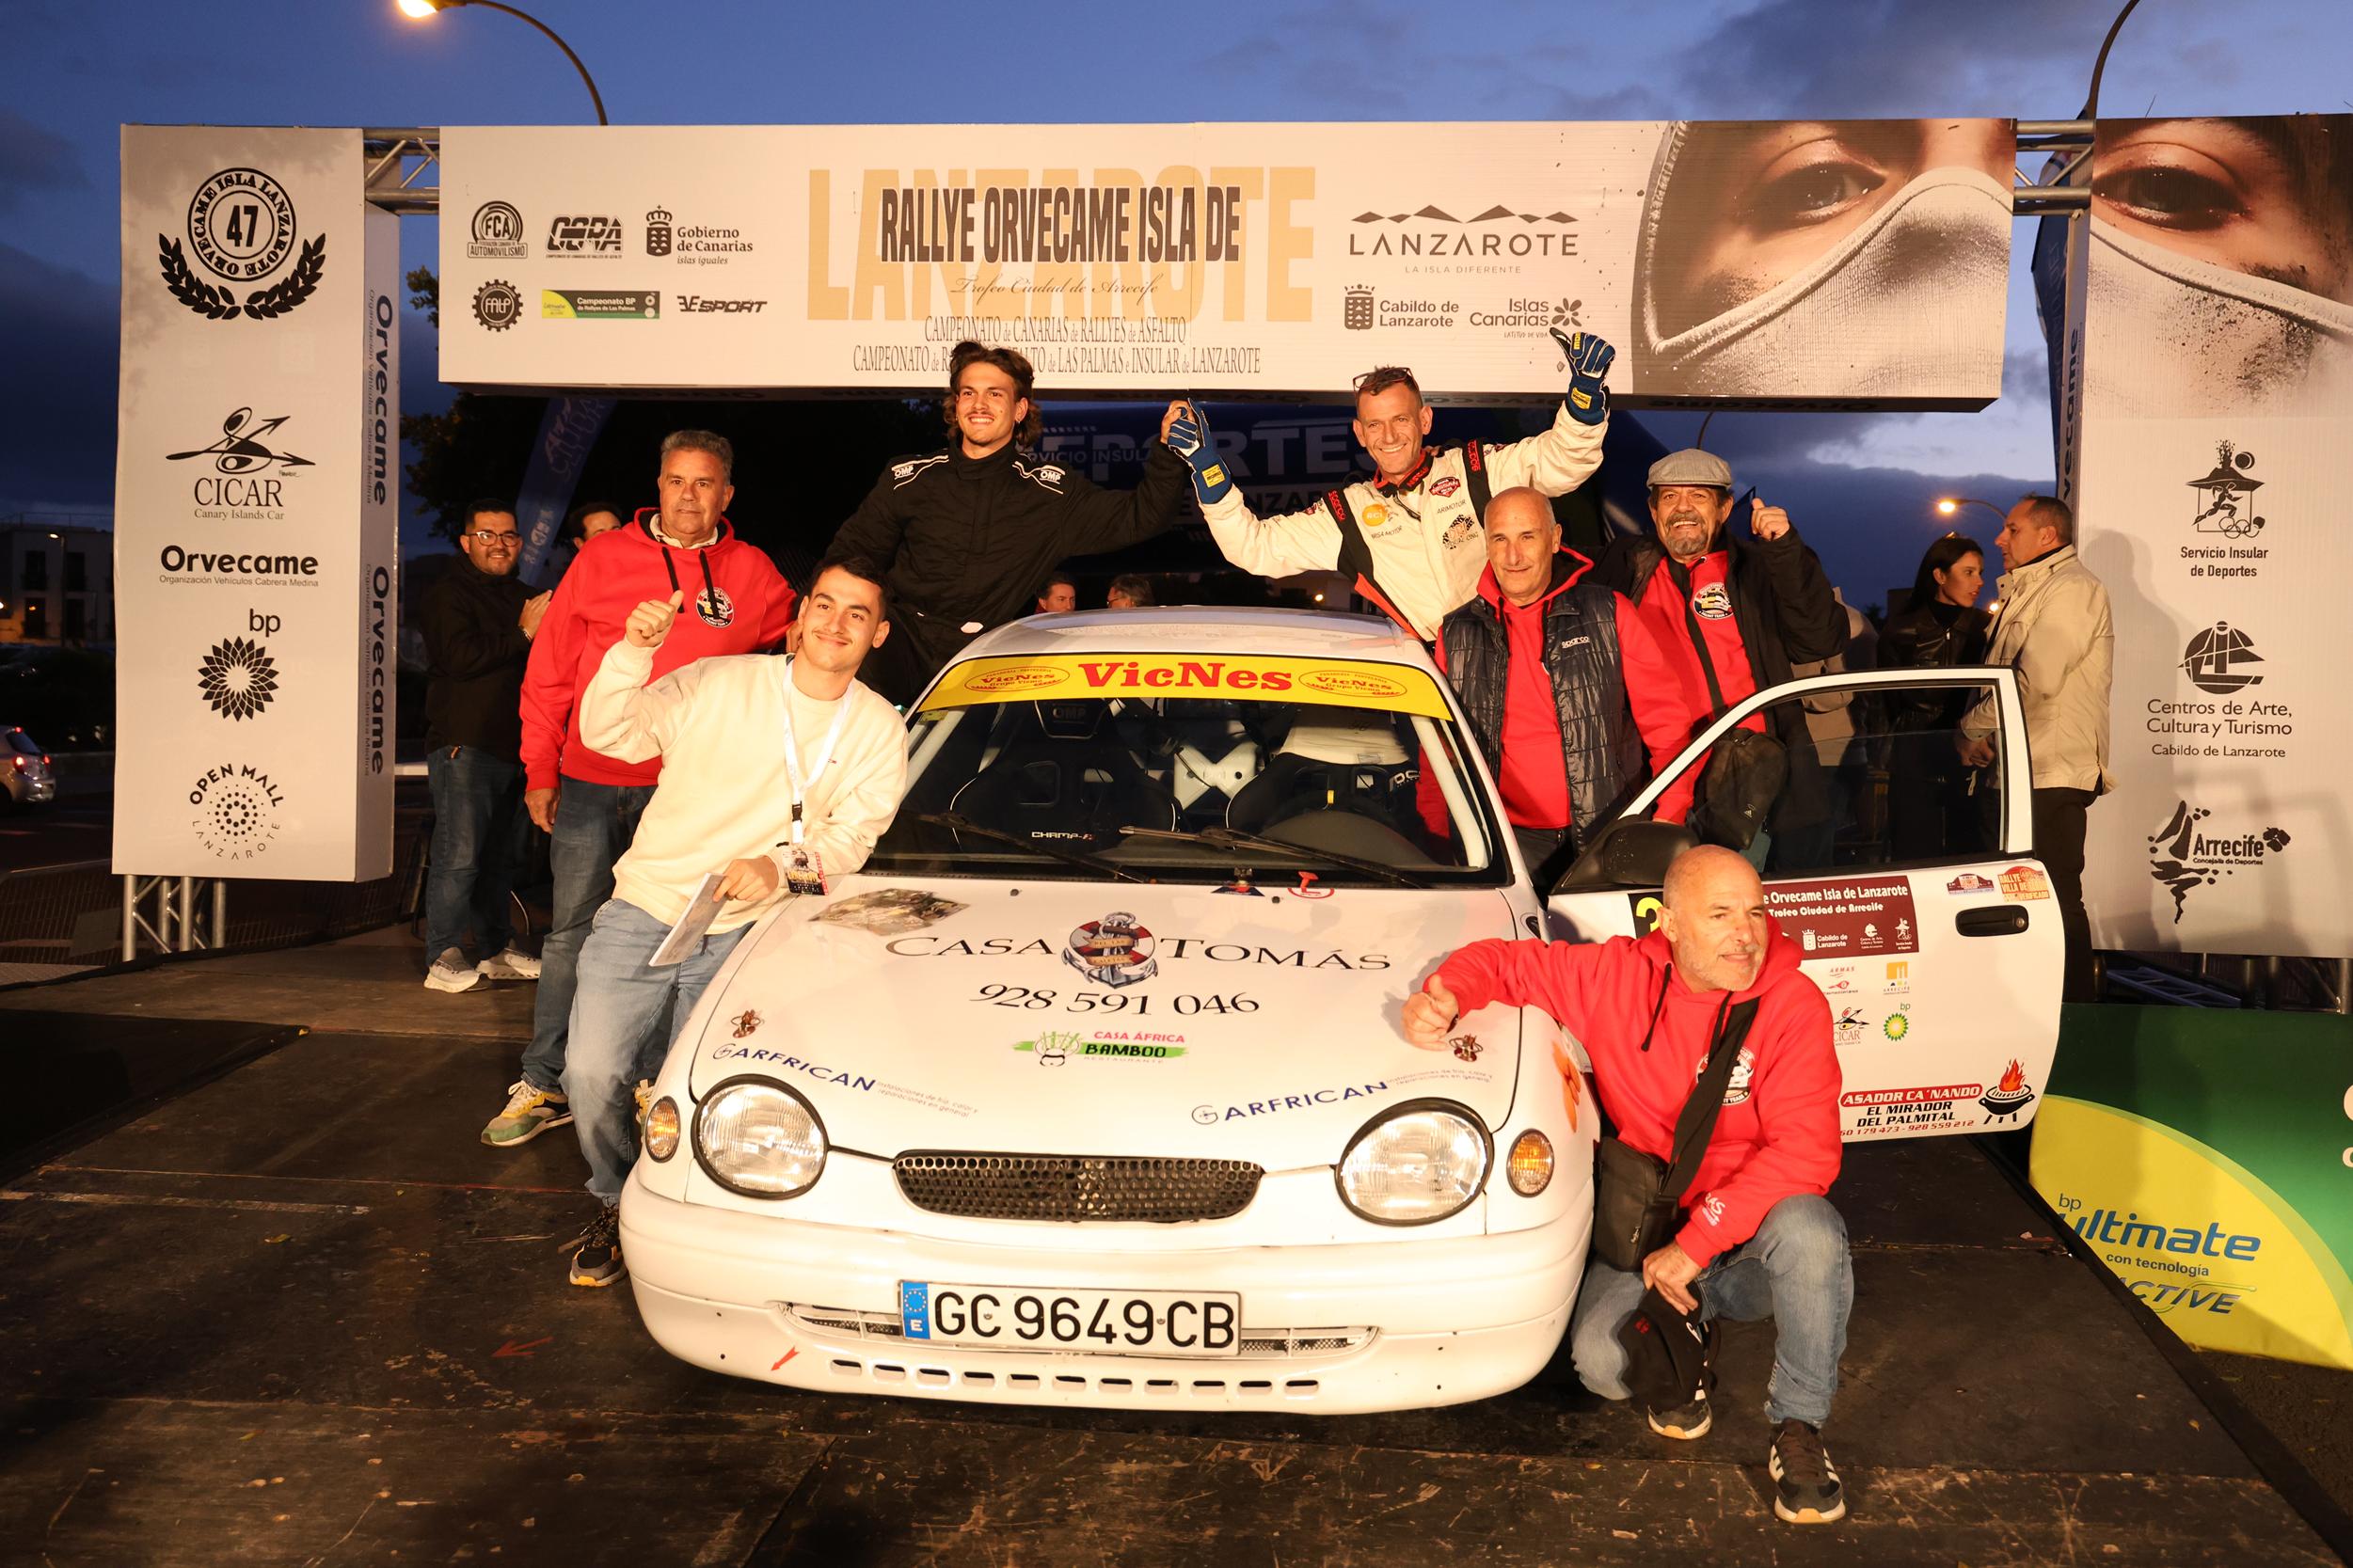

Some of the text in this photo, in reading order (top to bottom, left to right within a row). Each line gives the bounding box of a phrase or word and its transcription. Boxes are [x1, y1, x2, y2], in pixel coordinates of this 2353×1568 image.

[216, 172, 257, 191] ISLA
[244, 179, 292, 277] LANZAROTE
[227, 204, 259, 248] 47
[485, 215, 511, 238] FCA
[677, 226, 739, 239] Gobierno
[881, 185, 1242, 264] RALLYE ORVECAME ISLA DE
[469, 245, 525, 257] AUTOMOVILISMO
[677, 240, 754, 253] de Canarias
[806, 165, 1317, 325] LANZAROTE
[1350, 232, 1579, 256] LANZAROTE
[677, 255, 728, 266] islas iguales
[949, 275, 1164, 306] Trofeo Ciudad de Arrecife
[577, 297, 624, 306] Campeonato
[1379, 300, 1459, 313] Cabildo de
[1509, 297, 1550, 312] Islas
[1379, 314, 1454, 327] Lanzarote
[1470, 311, 1550, 327] Canarias
[925, 316, 1002, 343] CAMPEONATO
[1003, 328, 1011, 342] de
[1013, 316, 1069, 342] CANARIAS
[1071, 328, 1079, 342] de
[1080, 316, 1127, 343] RALLYES
[1129, 328, 1137, 342] de
[852, 344, 929, 372] CAMPEONATO
[931, 357, 941, 372] de
[1048, 359, 1056, 372] de
[1058, 347, 1078, 373] LAS
[1080, 347, 1123, 373] PALMAS
[1132, 347, 1181, 373] INSULAR
[1182, 359, 1190, 374] de
[1192, 347, 1262, 374] LANZAROTE
[374, 294, 393, 506] Orvecame
[895, 465, 914, 478] OMP
[1040, 468, 1061, 482] OMP
[194, 478, 283, 507] CICAR
[194, 509, 284, 522] Canary Islands Car
[161, 546, 319, 575] Orvecame
[2180, 546, 2269, 560] Servicio Insular
[159, 575, 319, 587] Organización Vehículos Cabrera Medina
[2190, 565, 2258, 579] de Deportes
[249, 608, 280, 638] bp
[1561, 635, 1590, 649] sparco
[372, 565, 390, 776] Orvecame
[980, 673, 1055, 683] VicNes
[1078, 662, 1293, 691] VicNes
[1315, 676, 1392, 690] VicNes
[2147, 699, 2293, 719] Centros de Arte,
[2146, 718, 2293, 737] Cultura y Turismo
[2152, 743, 2286, 758] Cabildo de Lanzarote
[189, 763, 284, 808] OPEN MALL
[191, 819, 280, 861] LANZAROTE
[2193, 833, 2265, 858] Arrecife
[1771, 890, 1822, 904] Orvecame
[1823, 888, 1840, 901] Isla
[1841, 887, 1856, 899] de
[1857, 885, 1908, 898] Lanzarote
[1768, 902, 1884, 918] Trofeo Ciudad de Arrecife
[883, 936, 1392, 970] CASA TOMÁS
[970, 983, 1261, 1016] 928 591 046
[1900, 1003, 1911, 1011] bp
[1093, 1030, 1185, 1043] CASA ÁFRICA
[1085, 1043, 1167, 1058] BAMBOO
[712, 1043, 876, 1091] GARFRICAN
[1191, 1081, 1389, 1125] GARFRICAN
[1843, 1091, 1903, 1105] ASADOR
[1867, 1101, 1952, 1117] EL MIRADOR
[1856, 1112, 1956, 1128] DEL PALMITAL
[2059, 1193, 2082, 1212] bp
[2106, 1252, 2209, 1276] con tecnología
[2119, 1277, 2241, 1314] CTIVE
[910, 1319, 924, 1332] E
[934, 1291, 1235, 1349] GC 9649 CB
